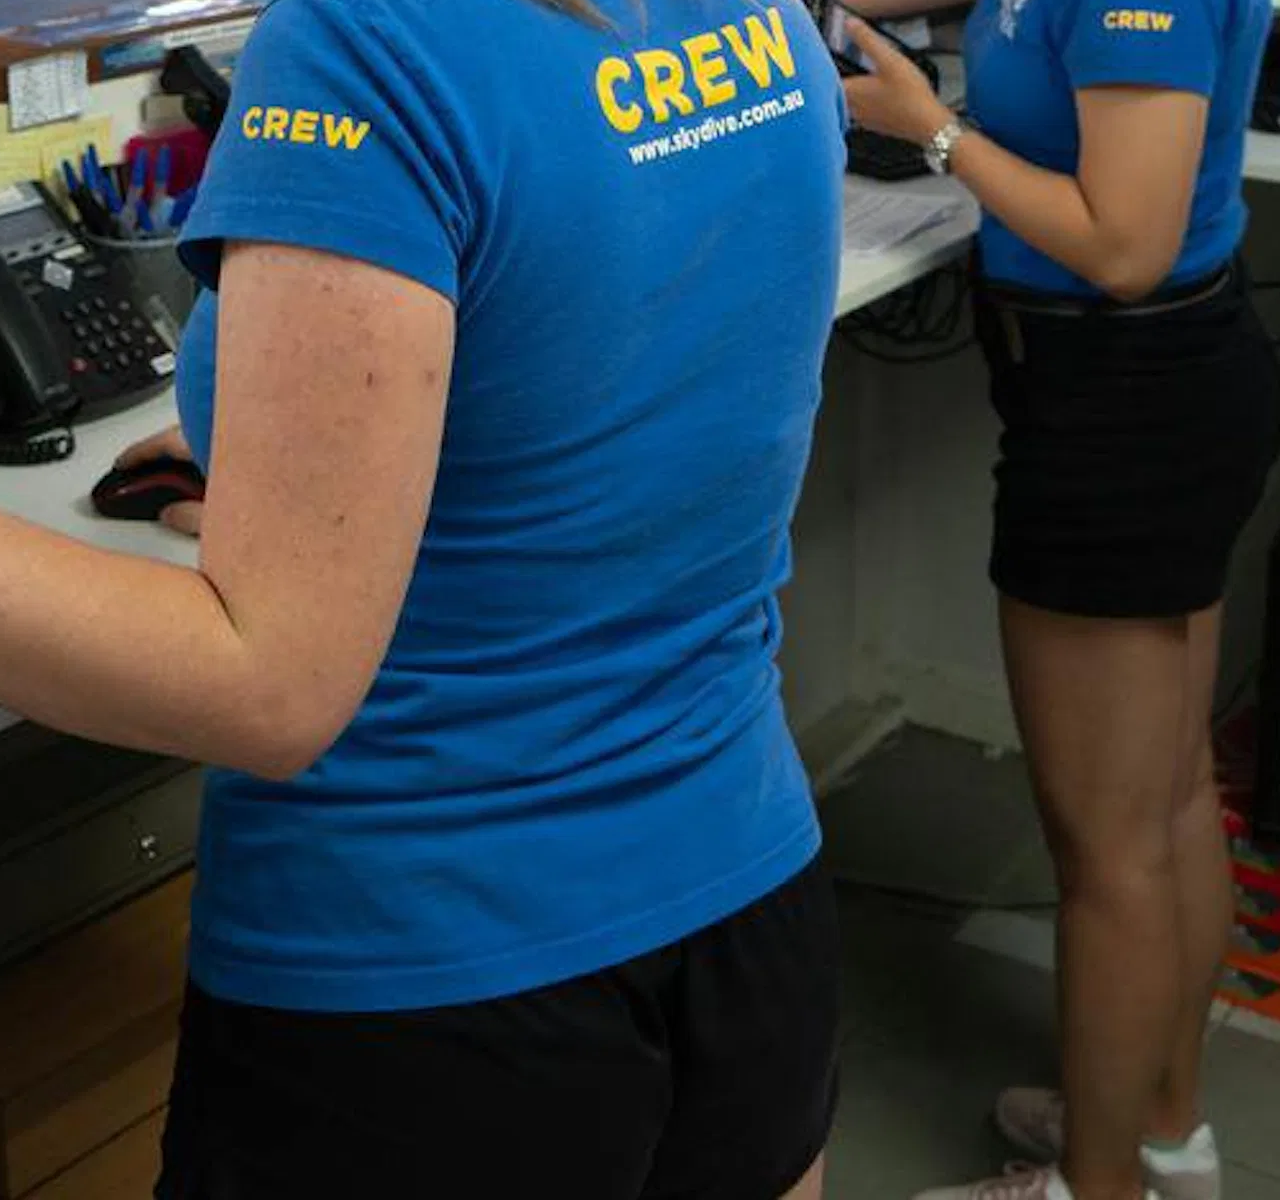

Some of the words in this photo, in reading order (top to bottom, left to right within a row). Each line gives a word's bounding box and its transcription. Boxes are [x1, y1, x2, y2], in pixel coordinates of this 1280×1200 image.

[1103, 10, 1175, 31] CREW
[596, 7, 796, 133] CREW
[242, 106, 371, 150] CREW
[628, 89, 805, 165] www.skydive.com.au
